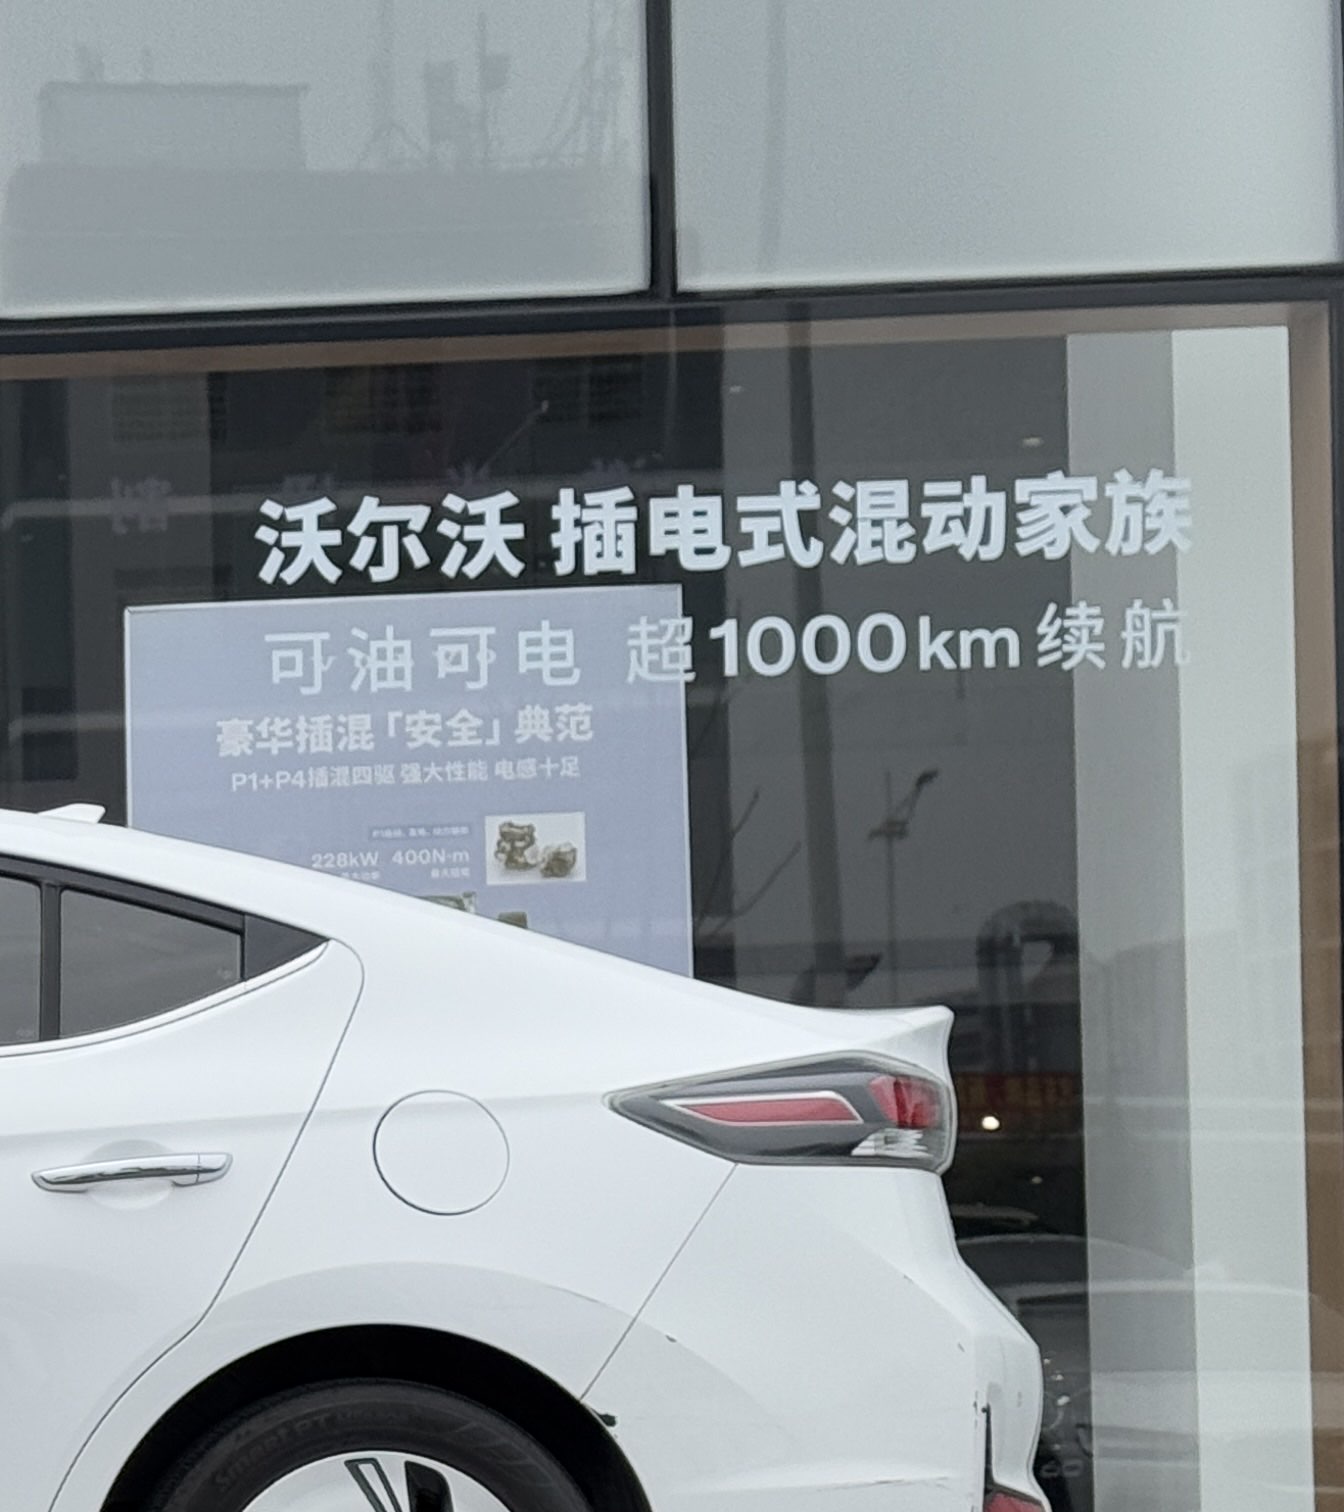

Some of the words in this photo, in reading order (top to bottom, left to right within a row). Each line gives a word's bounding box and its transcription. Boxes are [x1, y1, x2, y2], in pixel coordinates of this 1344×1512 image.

[254, 489, 527, 586] 沃尔沃
[550, 468, 1194, 577] 插电式混动家族
[264, 619, 582, 697] 可油可电
[514, 702, 594, 744] 典范
[399, 758, 489, 785] 强大性能
[311, 851, 380, 869] 228kW
